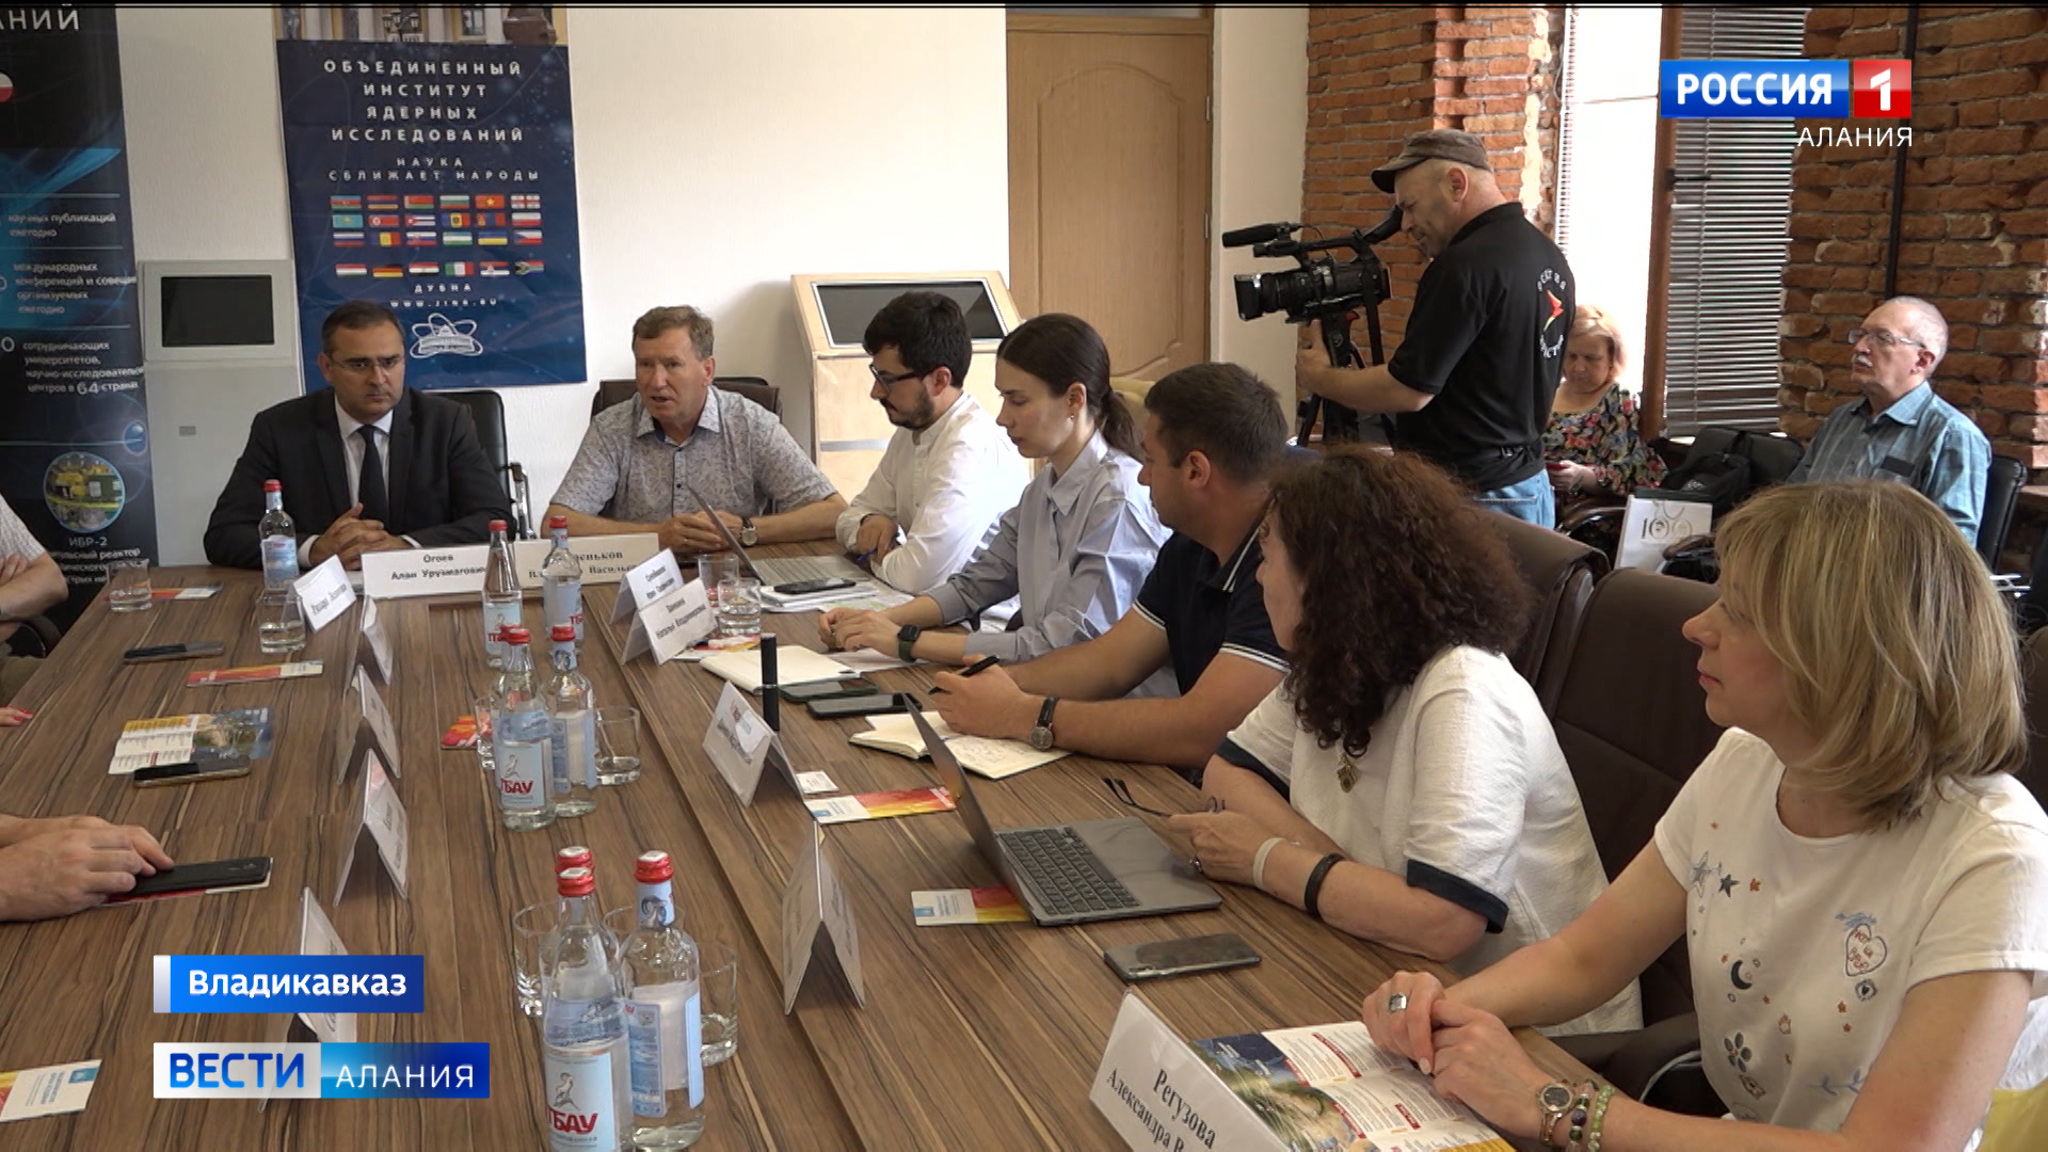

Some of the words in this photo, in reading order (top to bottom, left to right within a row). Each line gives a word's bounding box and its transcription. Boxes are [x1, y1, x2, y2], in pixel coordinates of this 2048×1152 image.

[0, 4, 80, 30] НИЙ
[323, 60, 521, 76] ОБЪЕДИНЕННЫЙ
[363, 83, 487, 97] ИНСТИТУТ
[366, 106, 478, 121] ЯДЕРНЫХ
[331, 127, 523, 143] ИССЛЕДОВАНИЙ
[397, 157, 463, 167] НАУКА
[328, 170, 441, 181] СБЛИЖАЕТ
[455, 171, 539, 182] НАРОДЫ
[414, 284, 472, 294] ДУБНА
[76, 381, 99, 395] 64
[69, 536, 109, 547] ИБР-2
[1107, 1068, 1171, 1149] Александра
[1153, 1069, 1216, 1149] Регузова
